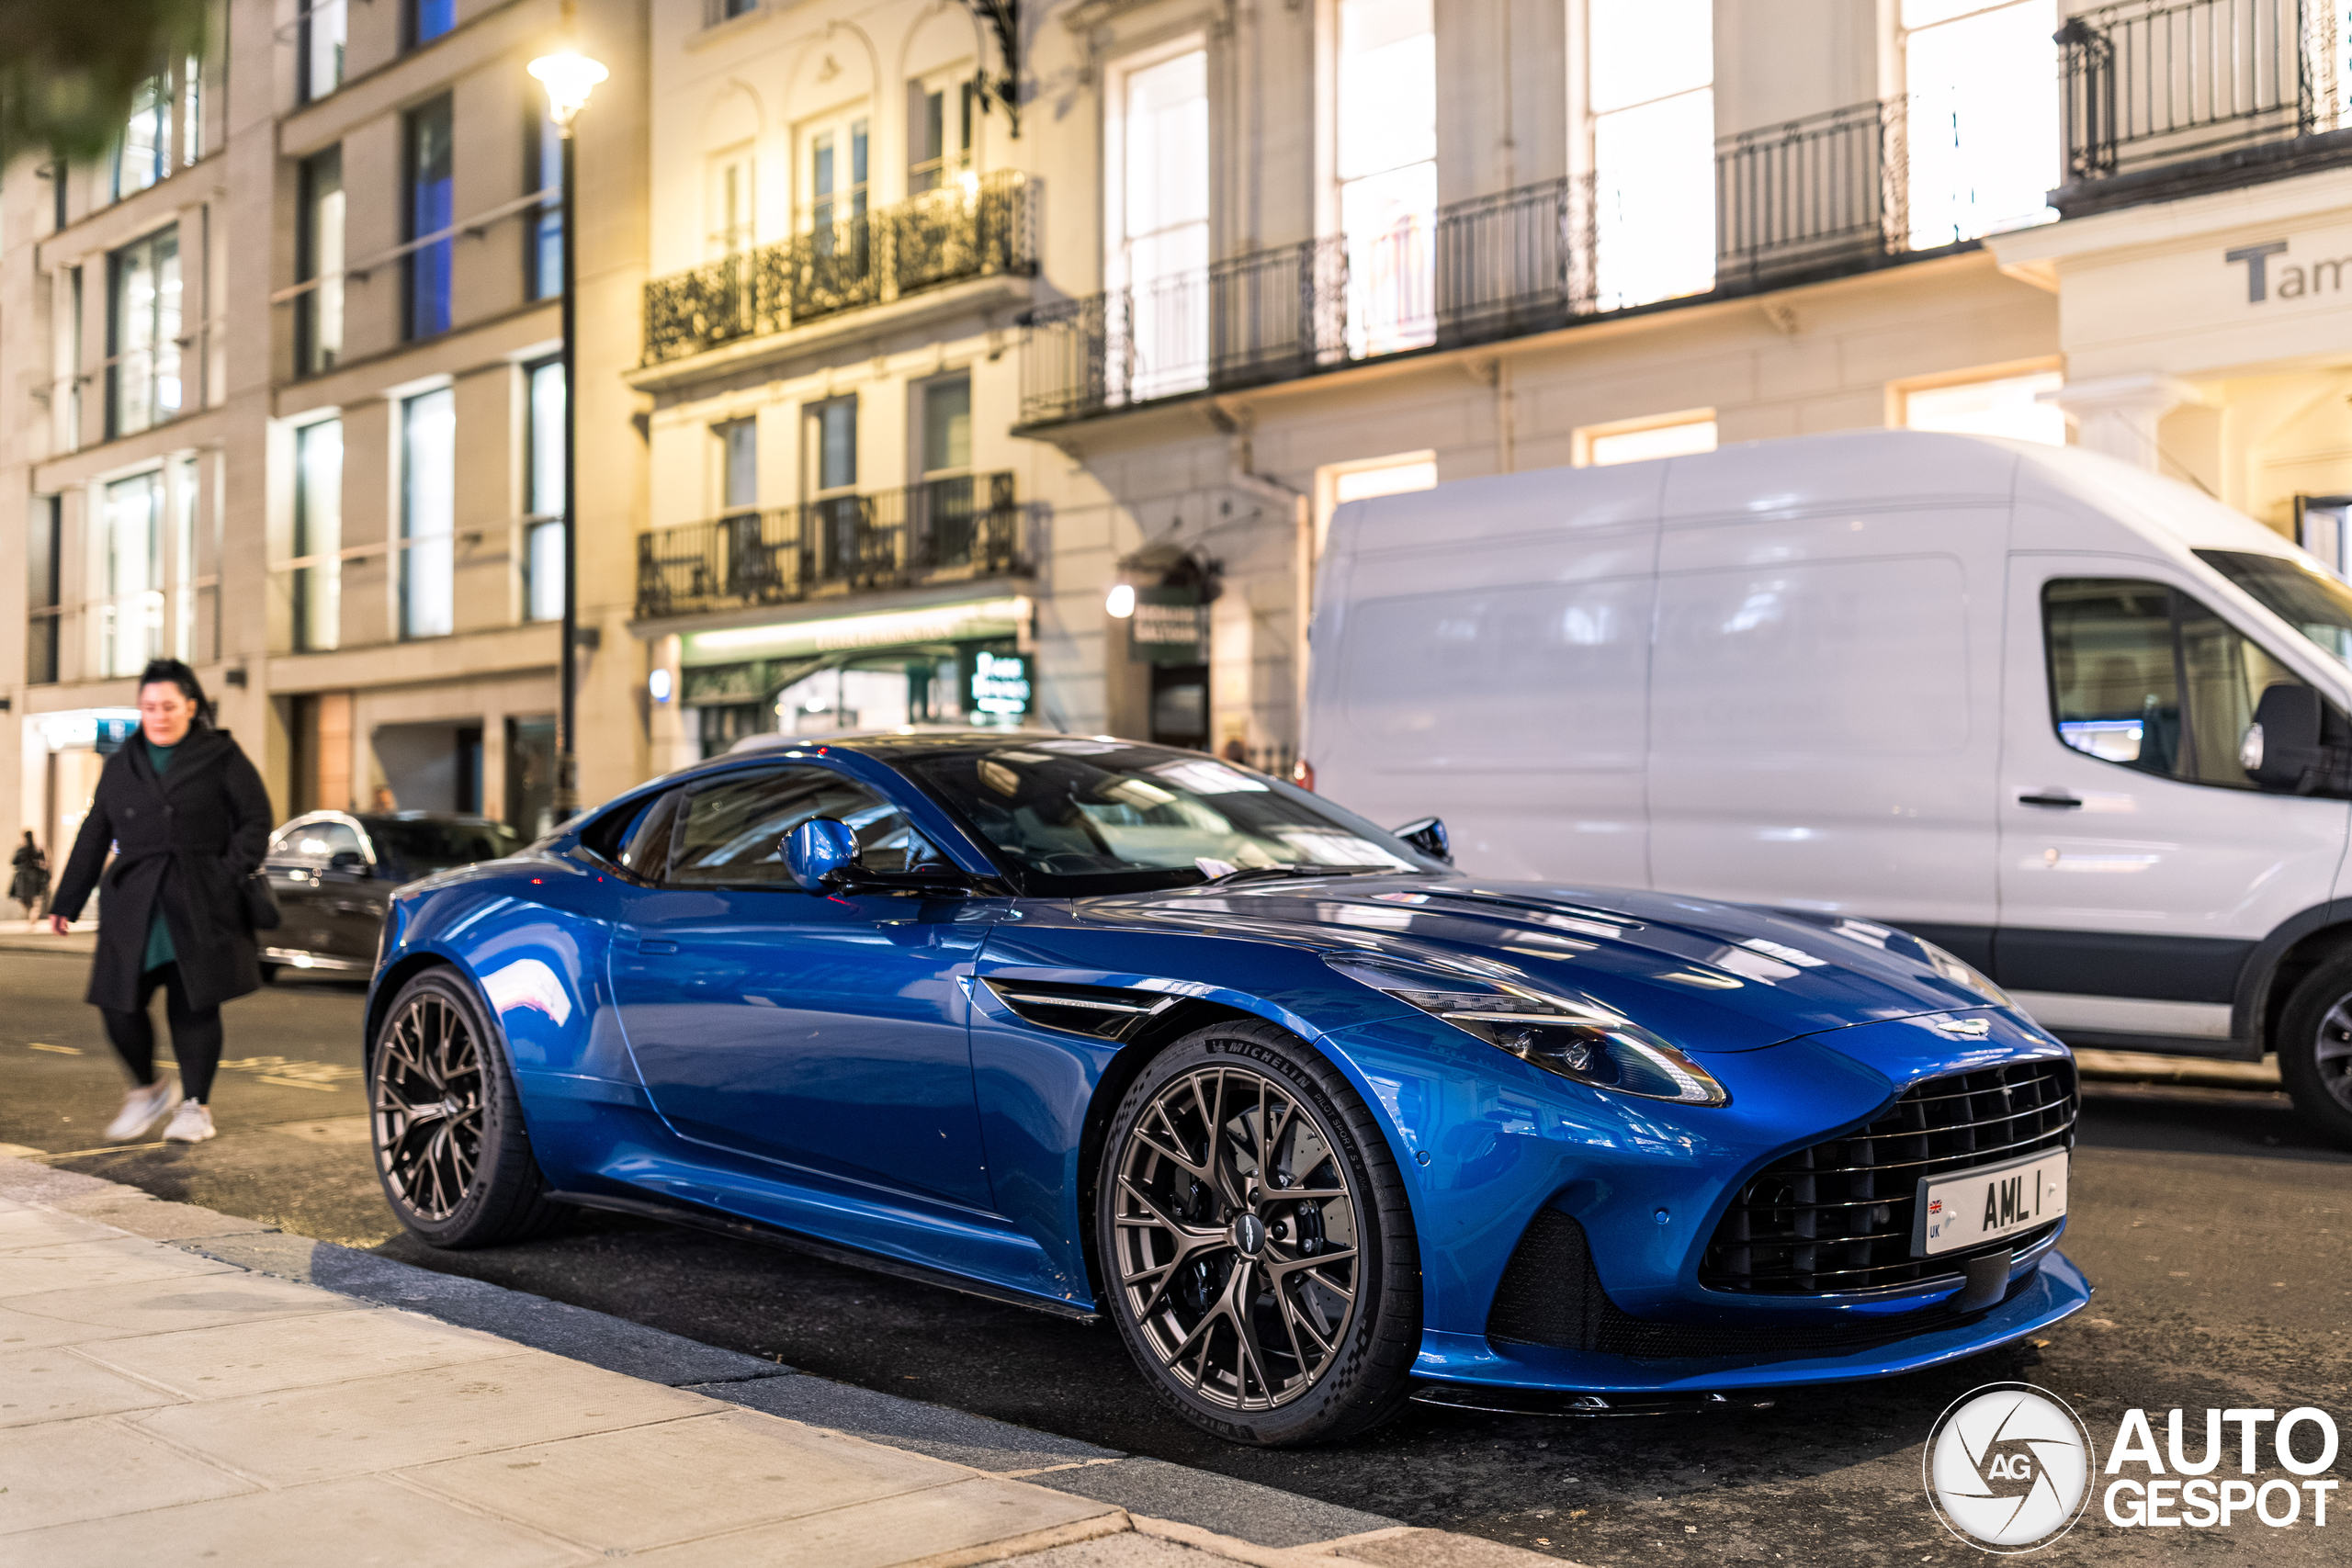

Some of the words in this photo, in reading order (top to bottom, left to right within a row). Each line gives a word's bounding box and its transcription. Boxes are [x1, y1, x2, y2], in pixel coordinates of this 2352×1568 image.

[1228, 1042, 1310, 1089] MICHELIN
[1314, 1093, 1336, 1117] PILOT
[1332, 1119, 1355, 1151] SPORT
[1929, 1224, 1939, 1238] UK
[1983, 1175, 2030, 1232] AML
[1155, 1379, 1229, 1434] MICHELIN
